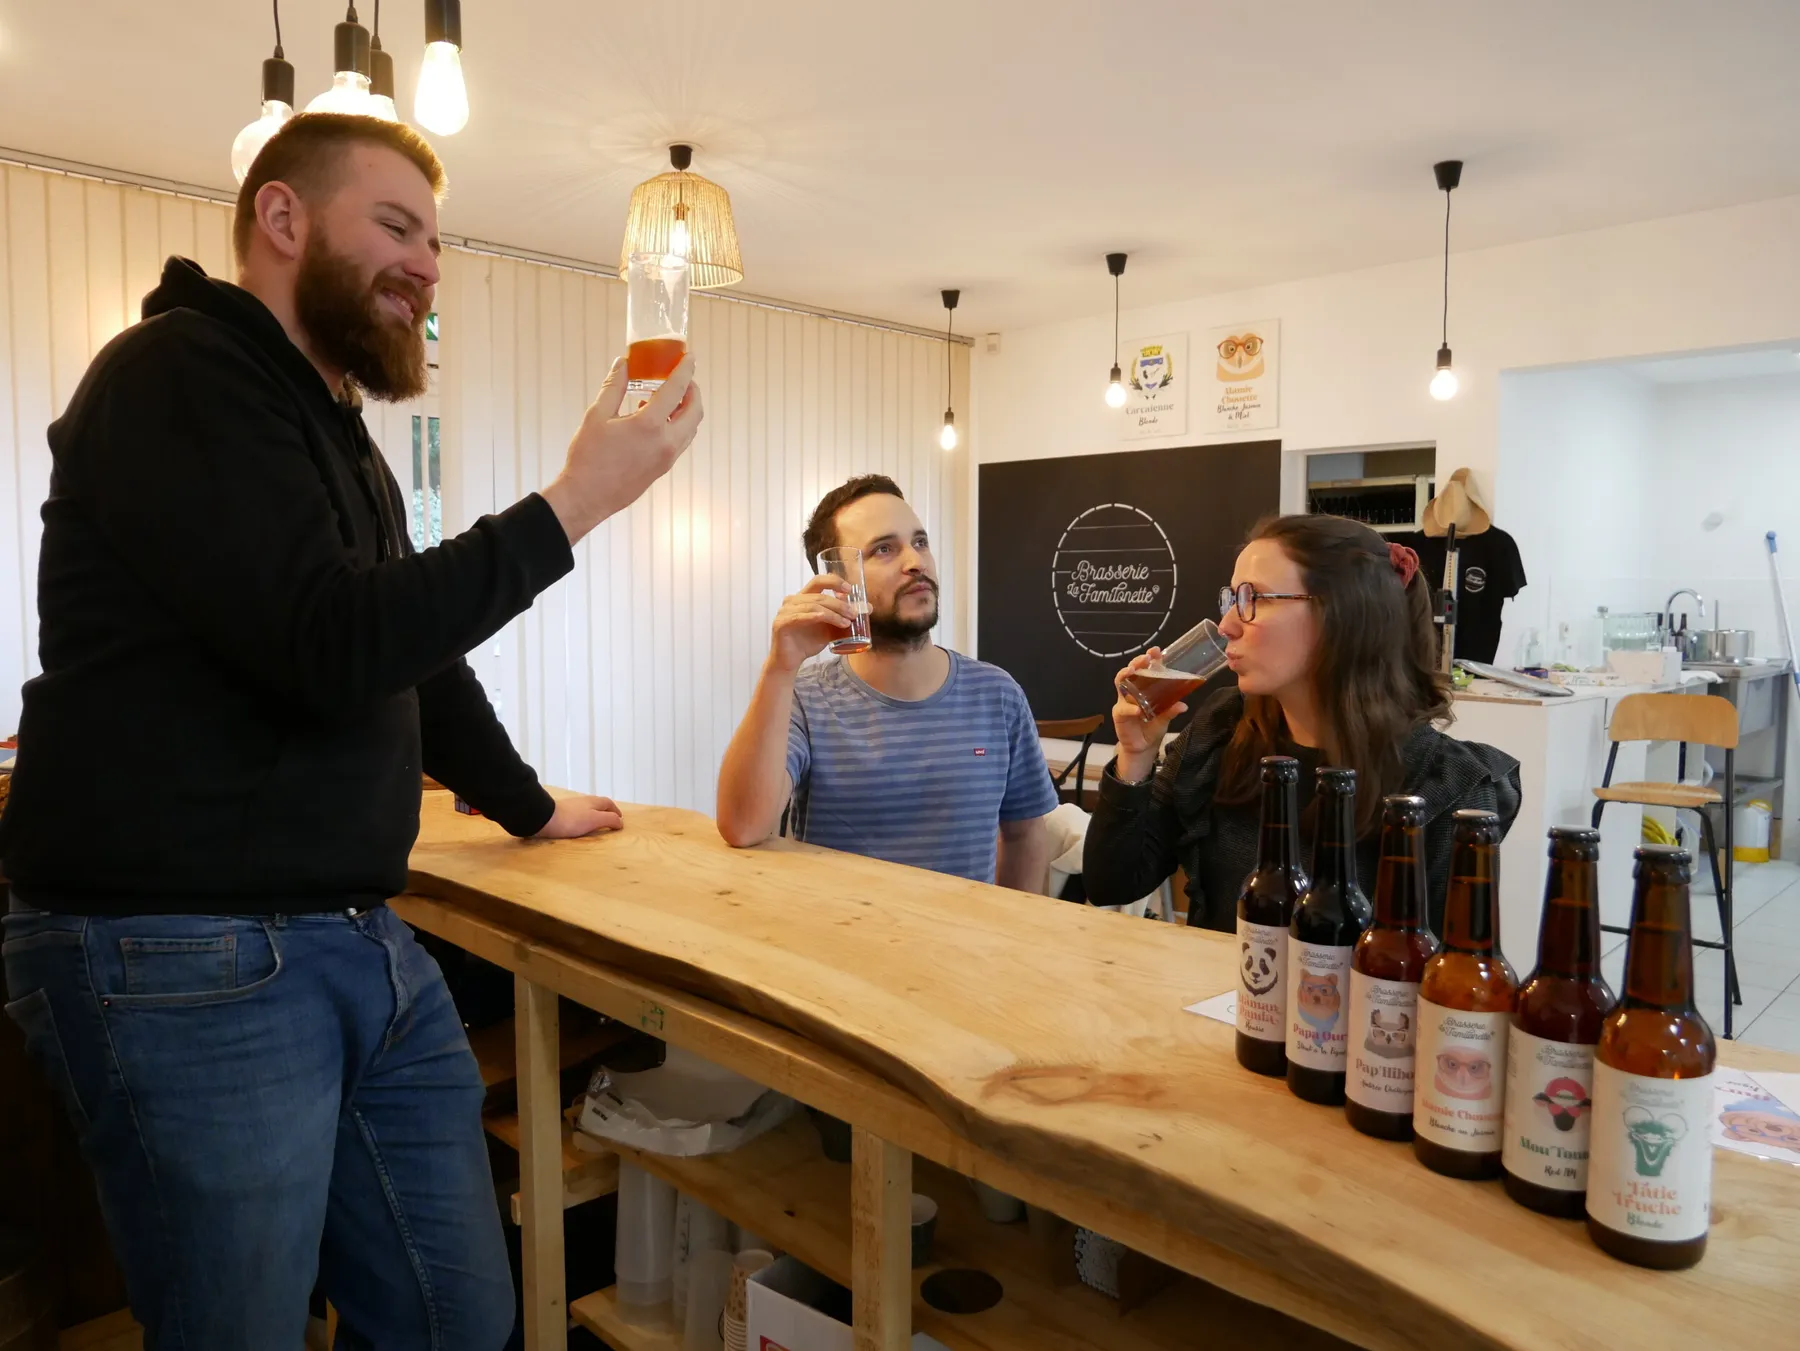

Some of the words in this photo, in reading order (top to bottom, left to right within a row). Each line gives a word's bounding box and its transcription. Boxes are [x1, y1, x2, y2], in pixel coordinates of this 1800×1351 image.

[1071, 560, 1150, 581] Brasserie
[1066, 581, 1080, 598] La
[1293, 1021, 1320, 1039] Papa
[1322, 1031, 1348, 1041] Our
[1544, 1164, 1561, 1177] Red
